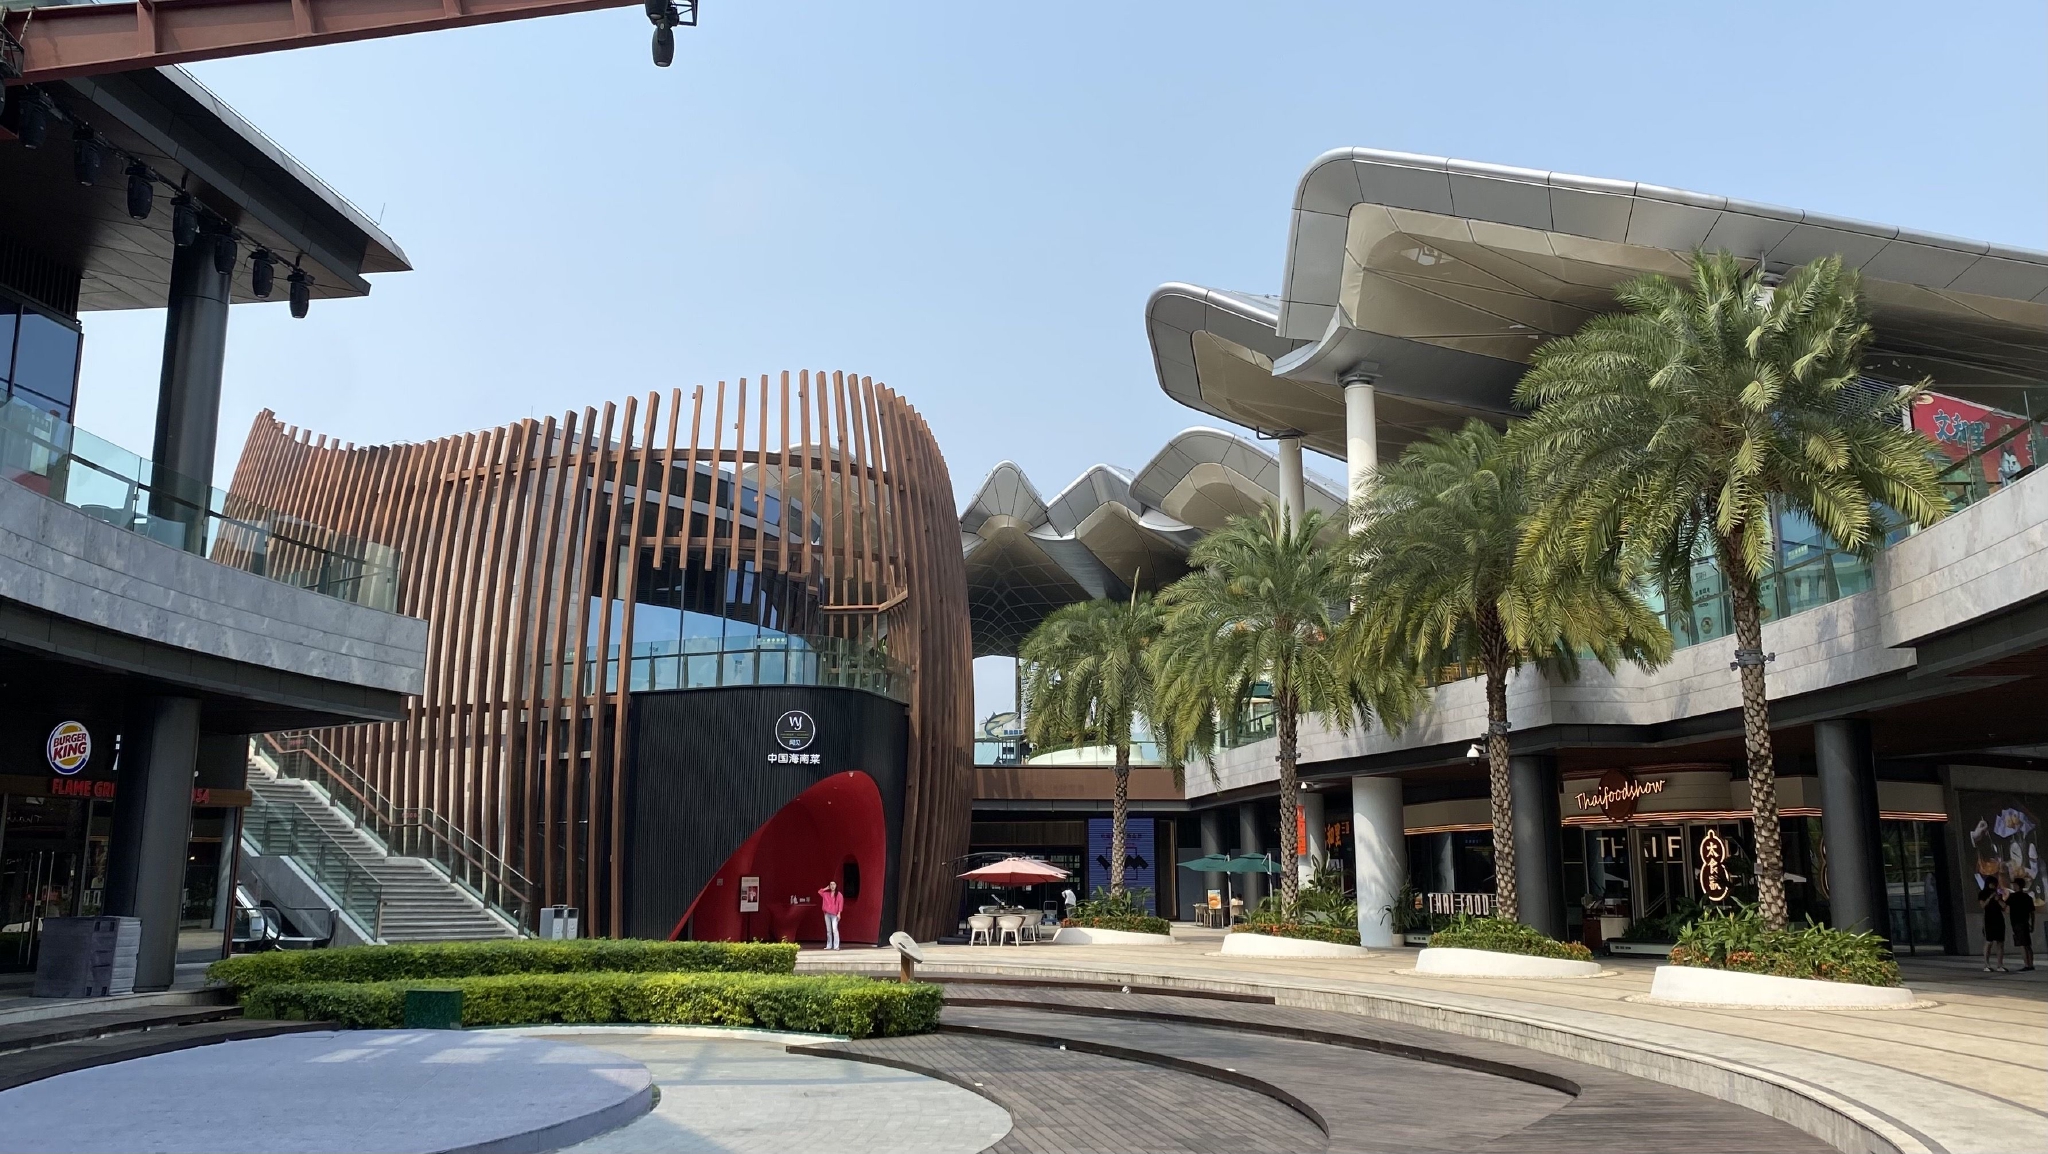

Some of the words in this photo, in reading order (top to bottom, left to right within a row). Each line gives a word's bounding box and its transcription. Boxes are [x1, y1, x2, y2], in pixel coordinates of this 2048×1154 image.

[53, 733, 87, 748] BURGER
[52, 742, 87, 762] KING
[767, 753, 821, 765] 中国海南菜
[51, 778, 92, 797] FLAME
[1575, 779, 1666, 810] Thaifoodshow
[1427, 892, 1455, 915] THAI
[1460, 893, 1490, 916] FOOD
